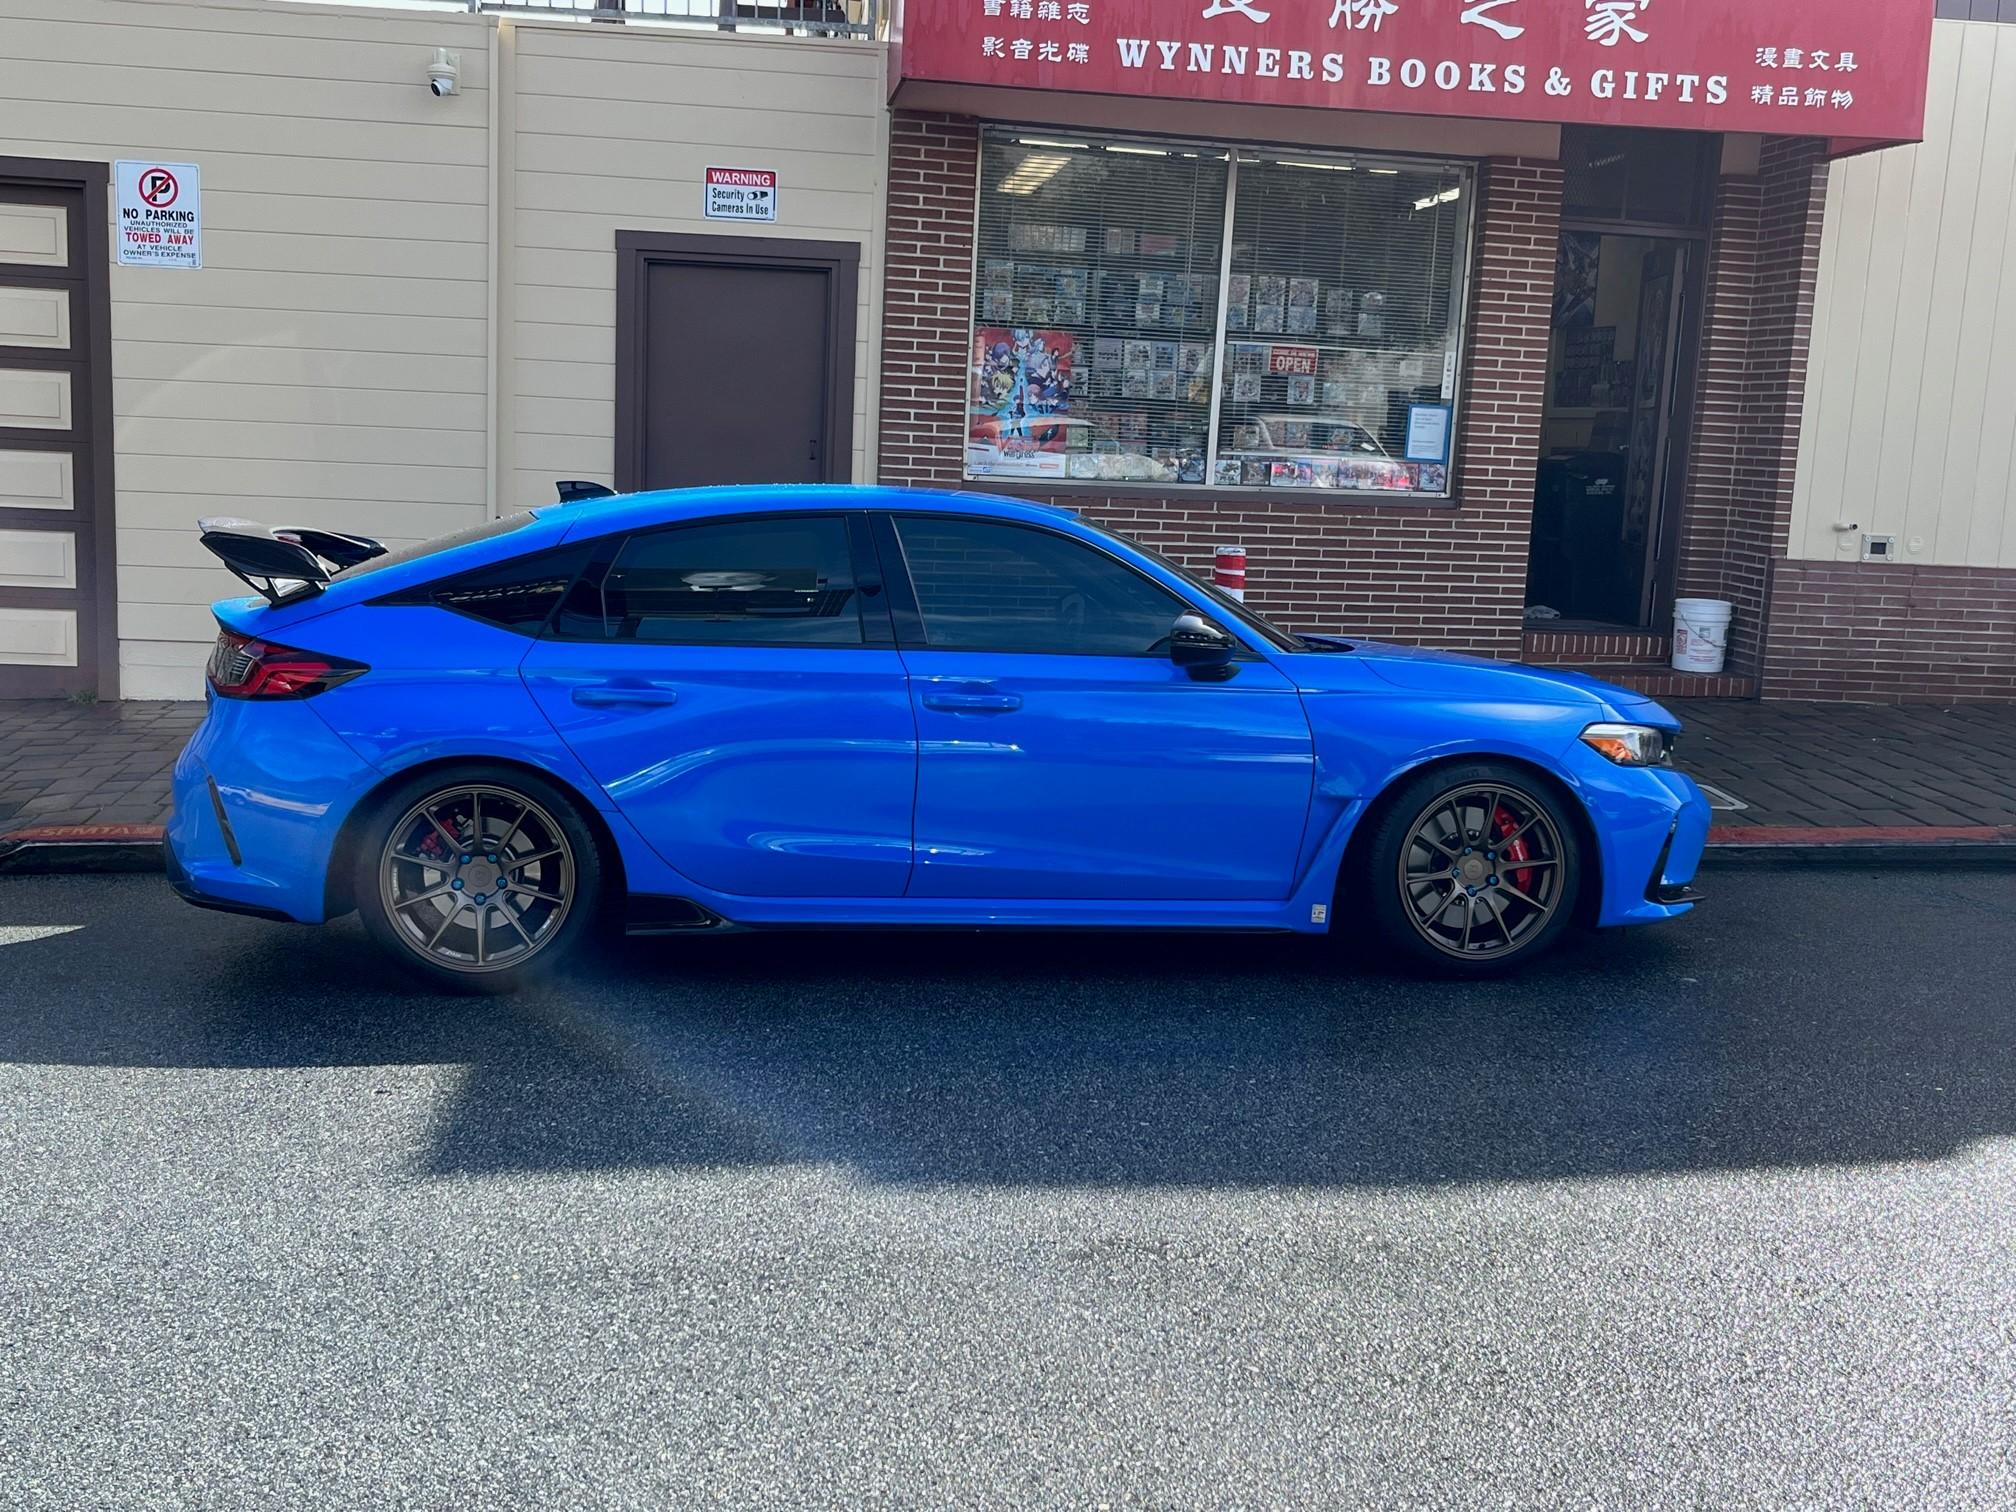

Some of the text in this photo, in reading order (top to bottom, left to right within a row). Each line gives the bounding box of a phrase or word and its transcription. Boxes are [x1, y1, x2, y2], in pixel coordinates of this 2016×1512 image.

[982, 36, 1090, 65] 影音光碟
[1755, 47, 1858, 72] 漫畫文具
[1116, 38, 1728, 105] WYNNERS BOOKS & GIFTS
[1751, 84, 1854, 110] 精品飾物
[711, 171, 771, 186] WARNING
[712, 187, 745, 203] Security
[123, 208, 195, 222] NO PARKING
[712, 201, 769, 215] Cameras In Use
[130, 220, 188, 229] UNAUTHORIZED
[125, 232, 194, 245] TOWED AWAY
[1275, 355, 1311, 374] OPEN
